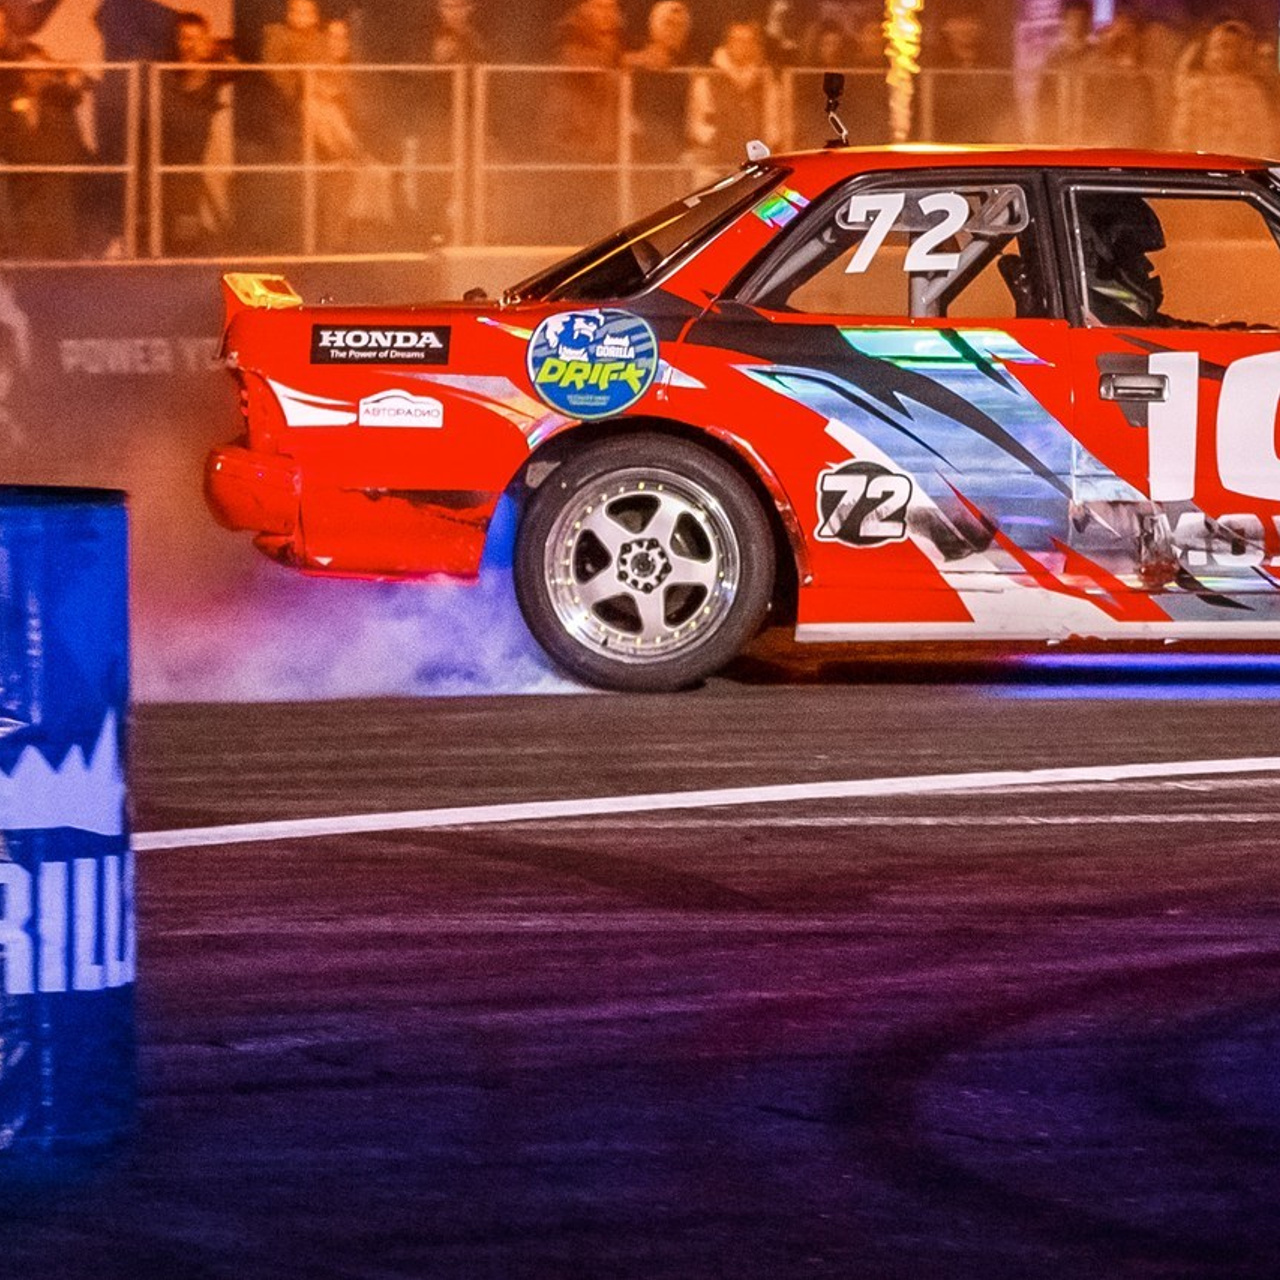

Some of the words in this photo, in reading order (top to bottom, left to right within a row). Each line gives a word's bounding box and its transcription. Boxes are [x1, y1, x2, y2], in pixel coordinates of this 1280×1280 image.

[844, 192, 970, 273] 72
[318, 330, 443, 349] HONDA
[330, 349, 347, 359] The
[349, 350, 377, 360] Power
[378, 350, 389, 359] of
[390, 350, 425, 360] Dreams
[595, 345, 635, 359] GORILLA
[535, 357, 646, 395] DRIFT
[820, 474, 910, 538] 72
[0, 855, 136, 994] RILL
